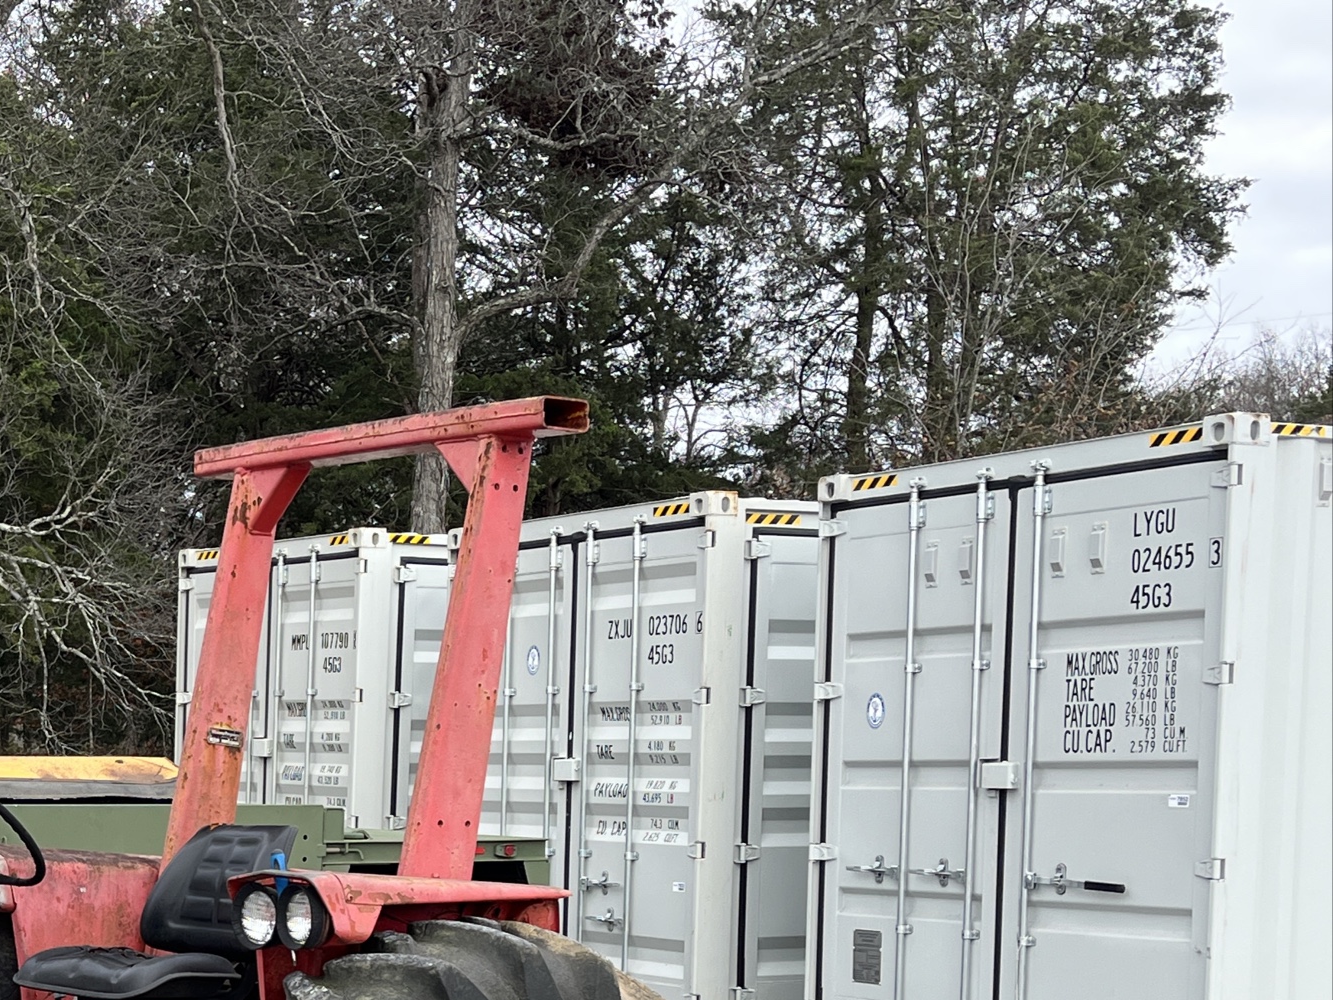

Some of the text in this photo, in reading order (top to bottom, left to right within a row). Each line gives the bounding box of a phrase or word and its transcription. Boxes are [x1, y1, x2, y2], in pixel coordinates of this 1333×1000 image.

[1133, 507, 1176, 538] LYGU
[1131, 539, 1221, 574] 024655 3
[1130, 582, 1172, 610] 45G3
[607, 612, 703, 640] ZXJU 023706 6
[320, 632, 349, 649] 107790
[647, 643, 674, 665] 45G3
[1066, 646, 1179, 677] MAX.GROSS 30.480 KG
[322, 656, 342, 673] 45G3
[1127, 660, 1177, 675] 67.200 LB
[1066, 673, 1177, 703] TARE 4.370 KG
[1132, 687, 1176, 701] 9.640 LB
[1064, 700, 1177, 728] PAYLOAD 26.110 KG
[1125, 713, 1175, 728] 57.560 LB
[1144, 727, 1156, 740] 73
[596, 744, 615, 760] TARE
[1130, 740, 1156, 754] 2.579
[593, 782, 628, 798] PAYLOAD
